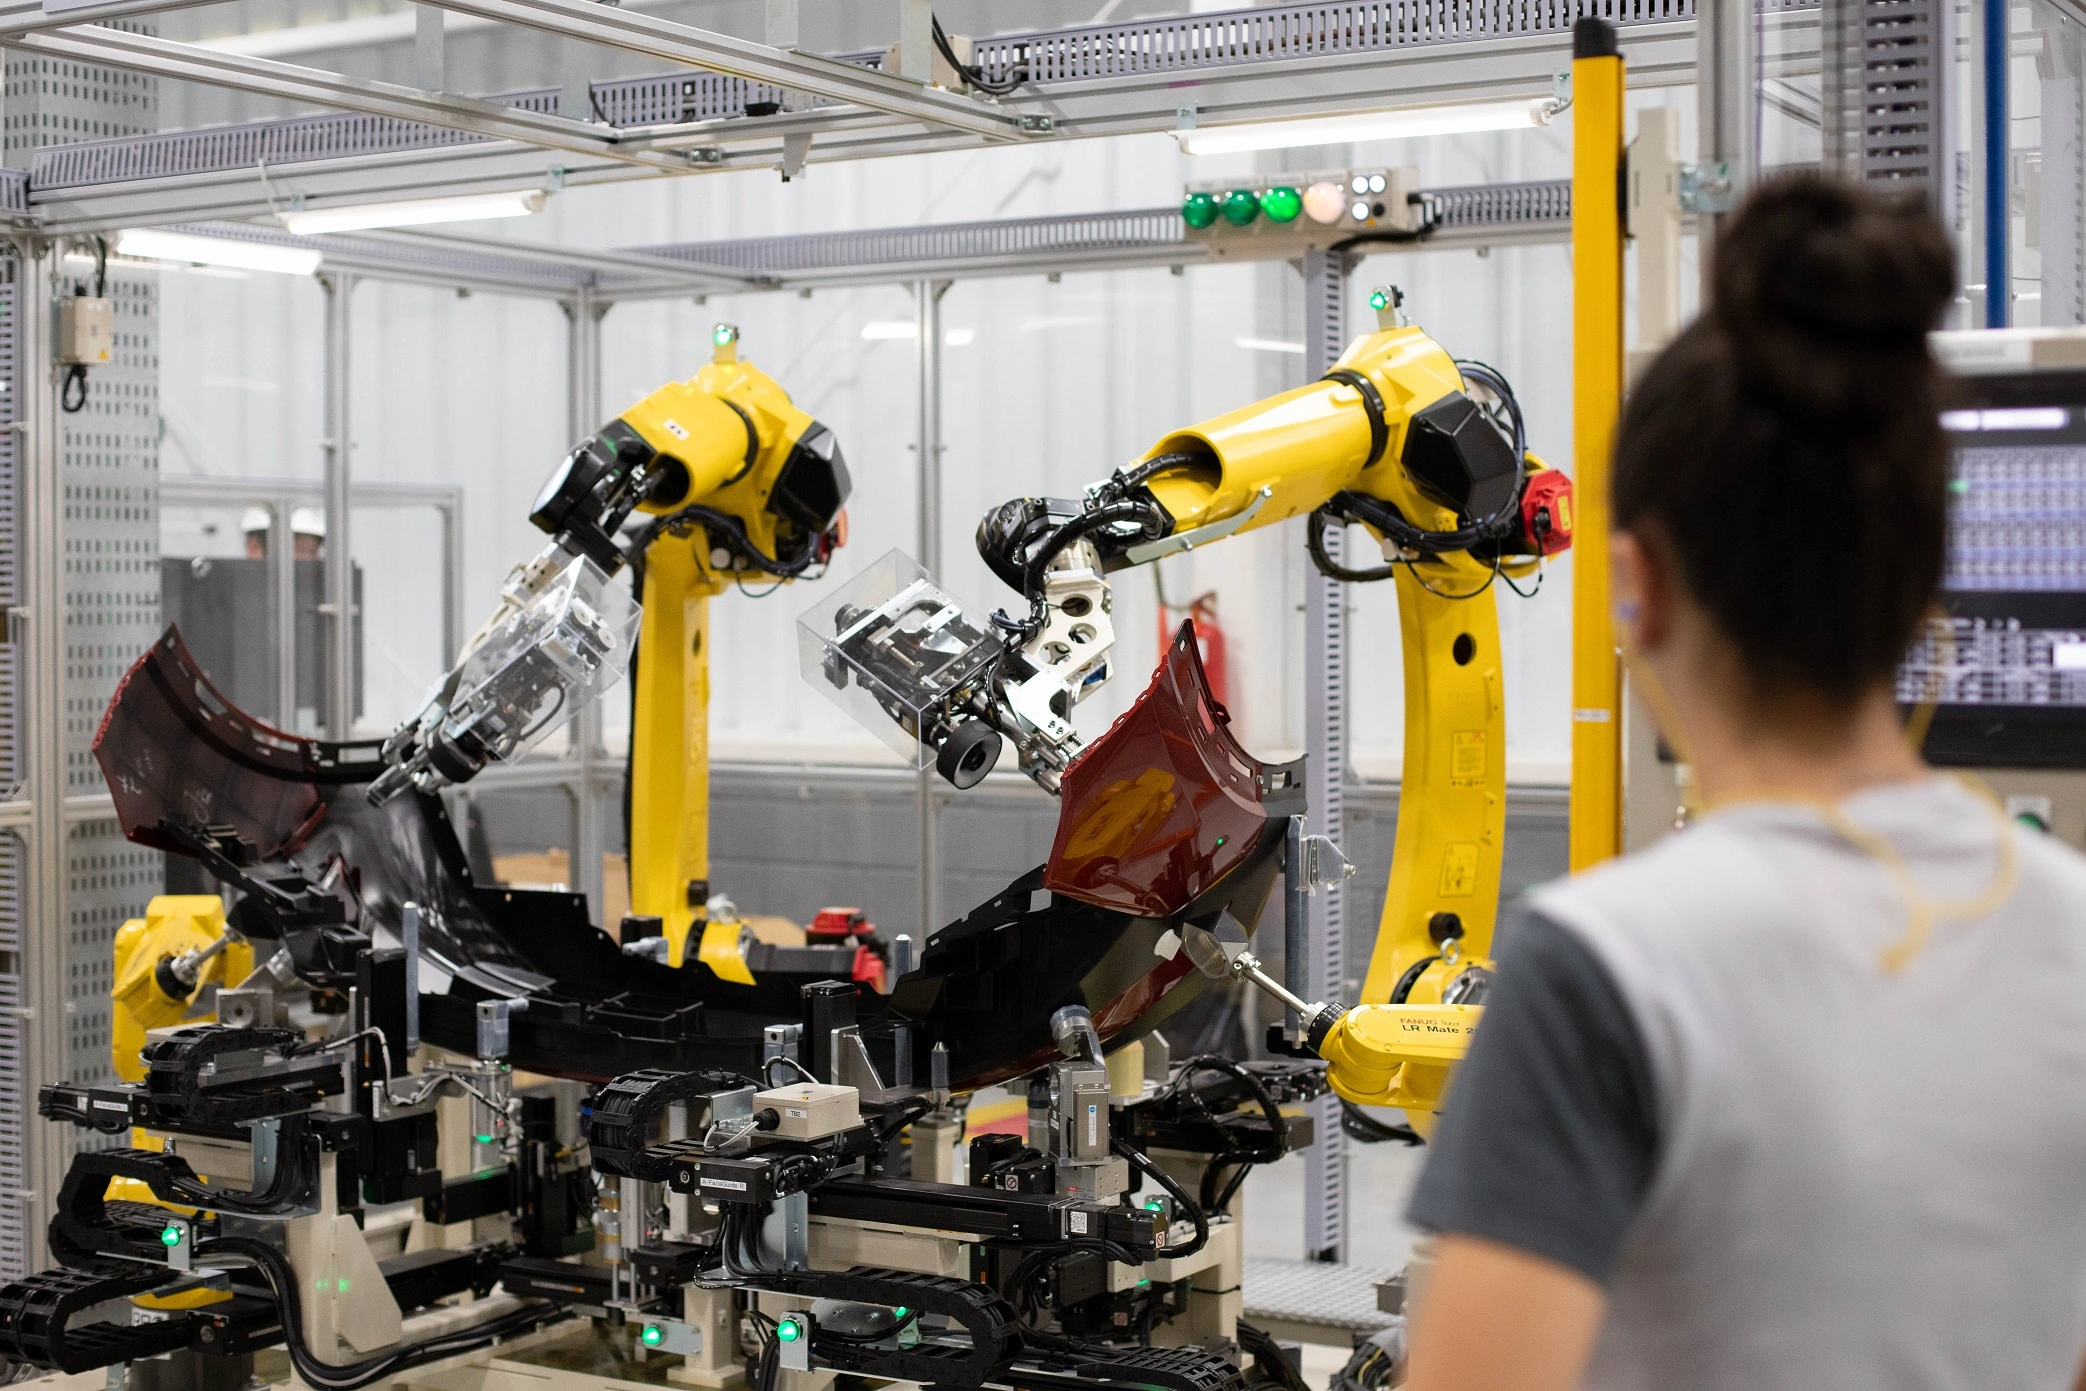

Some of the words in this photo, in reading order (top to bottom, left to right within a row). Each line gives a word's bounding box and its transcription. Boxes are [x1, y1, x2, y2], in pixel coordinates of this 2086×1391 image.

[1402, 1024, 1420, 1032] LR
[1427, 1025, 1459, 1033] Mate
[790, 1110, 801, 1118] TB2
